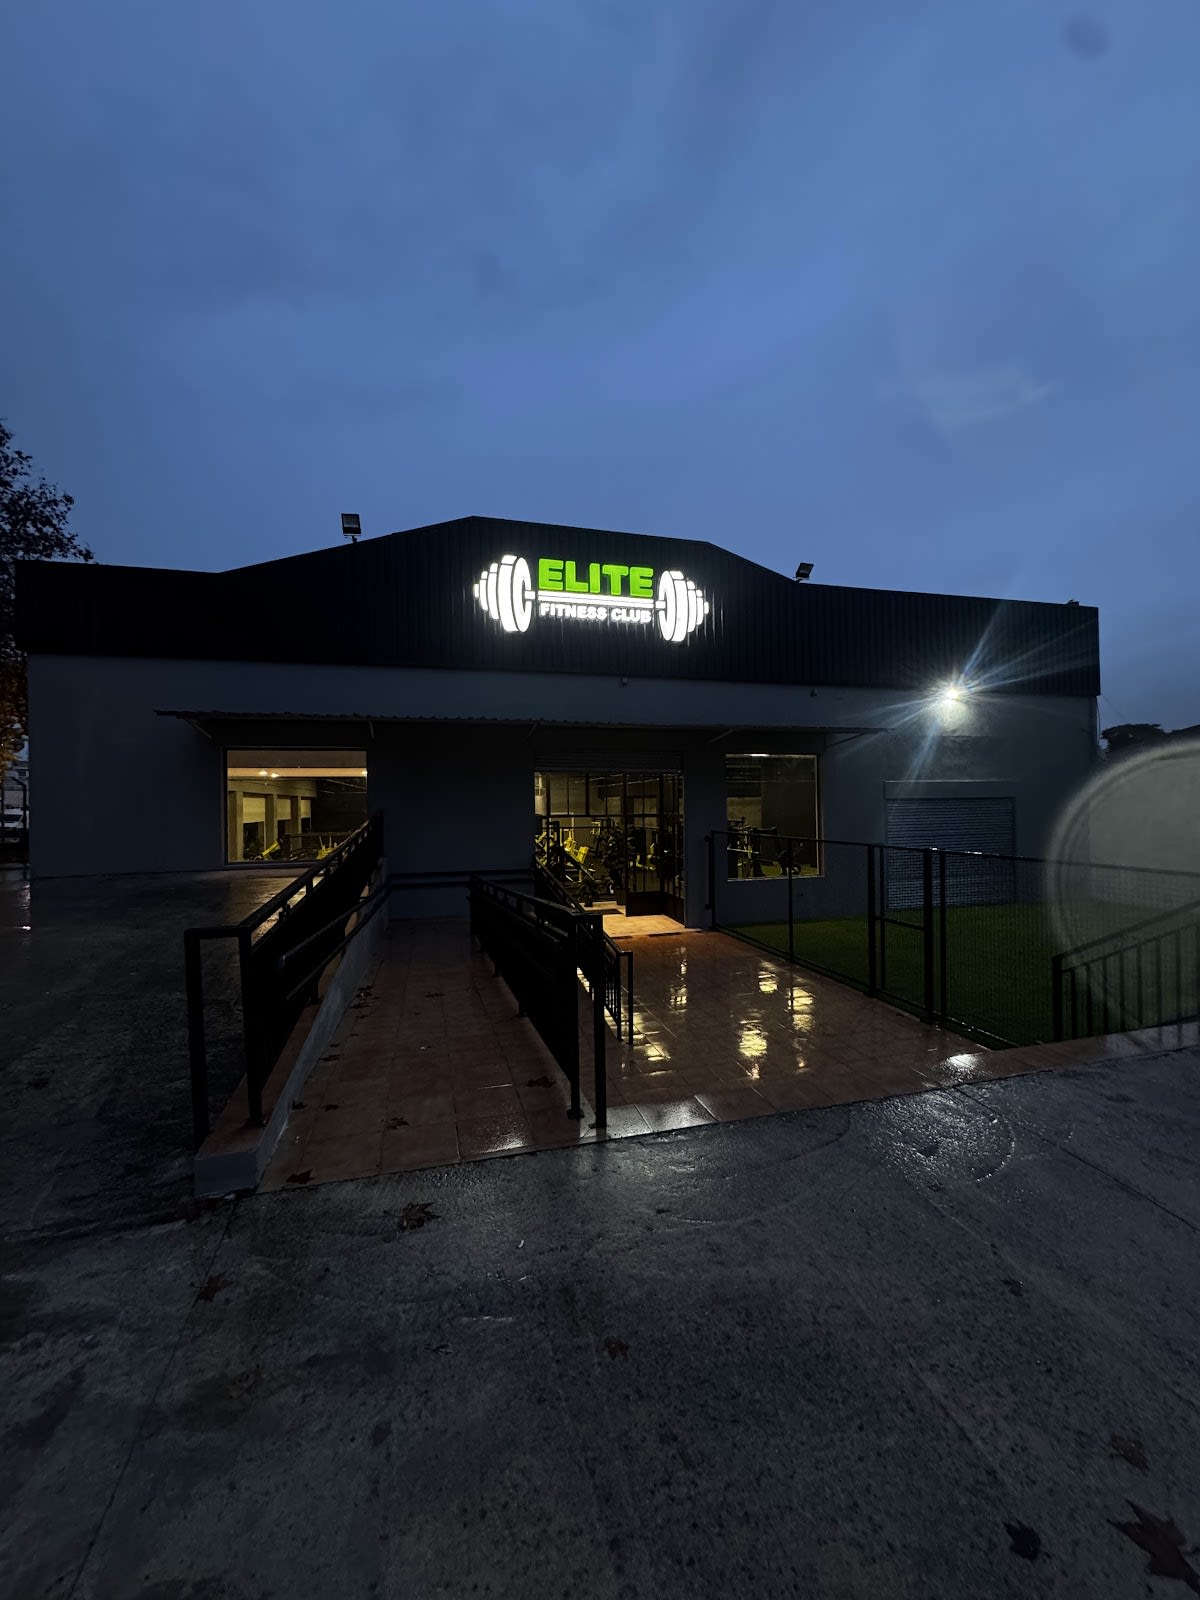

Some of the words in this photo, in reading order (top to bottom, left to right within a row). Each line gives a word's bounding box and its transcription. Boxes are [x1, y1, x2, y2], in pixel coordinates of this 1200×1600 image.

[538, 558, 654, 598] ELITE
[540, 602, 608, 620] FITNESS
[611, 607, 652, 624] CLUB
